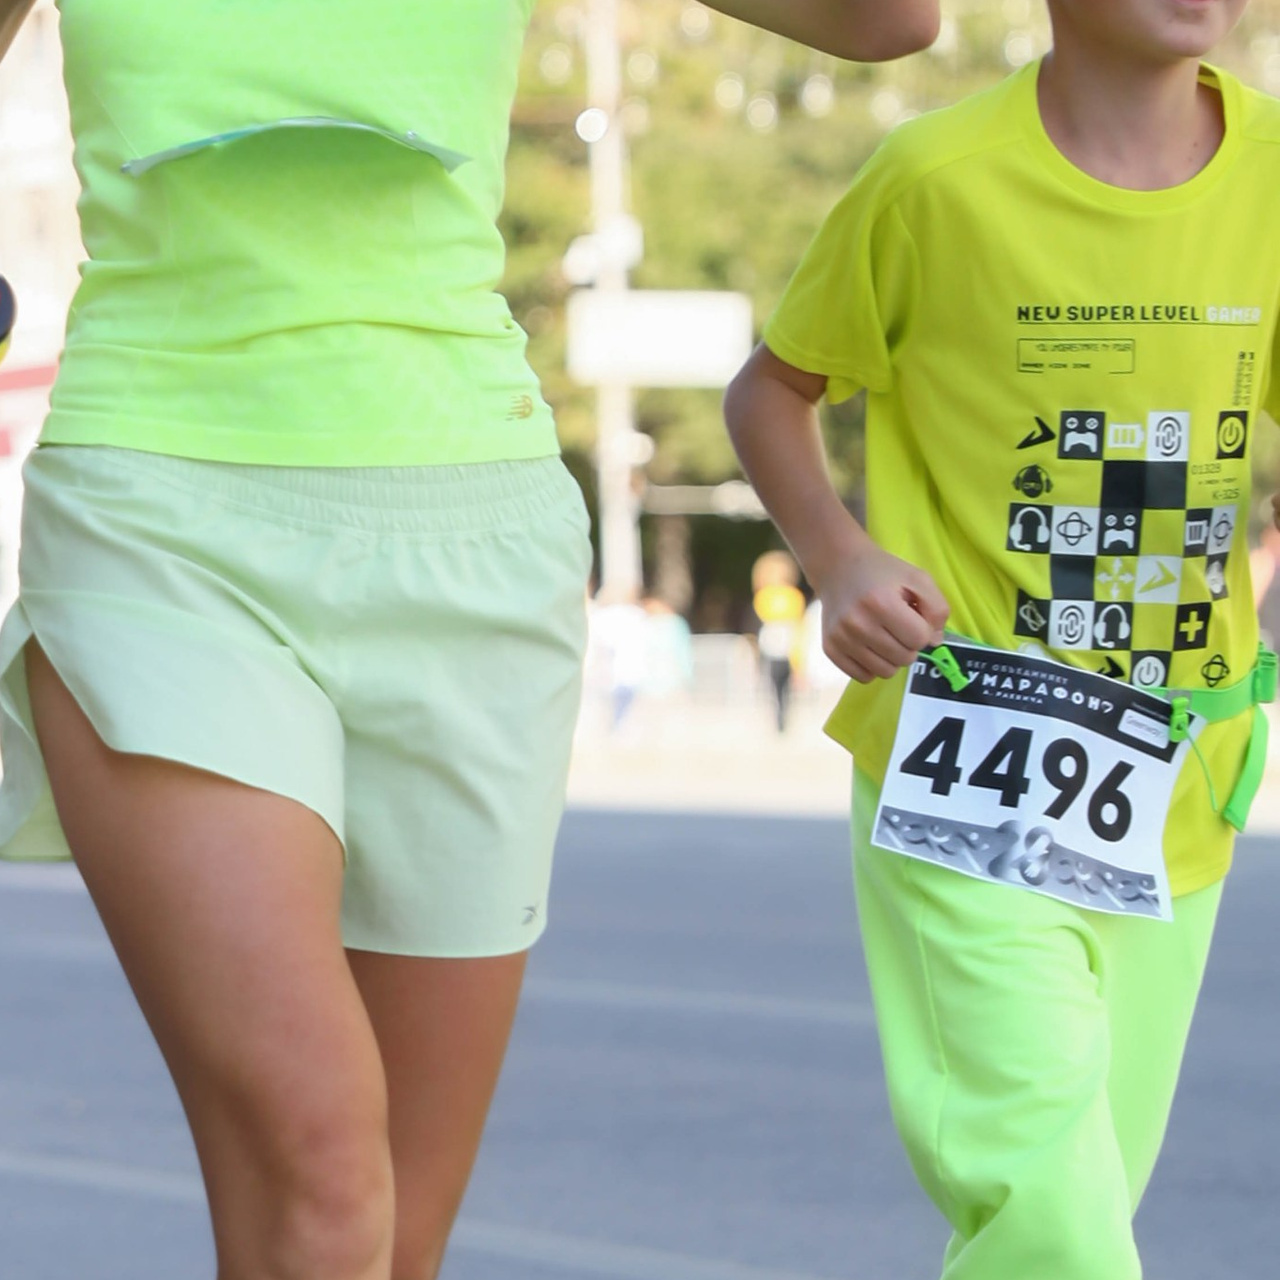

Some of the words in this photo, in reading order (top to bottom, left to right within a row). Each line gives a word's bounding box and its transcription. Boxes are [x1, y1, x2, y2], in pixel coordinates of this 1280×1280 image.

[1017, 305, 1060, 321] NEW
[1066, 305, 1135, 321] SUPER
[1140, 305, 1200, 322] LEVEL
[1206, 307, 1261, 323] GAMER
[914, 661, 1102, 711] ПОУМАРАФОН
[899, 716, 1136, 843] 4496
